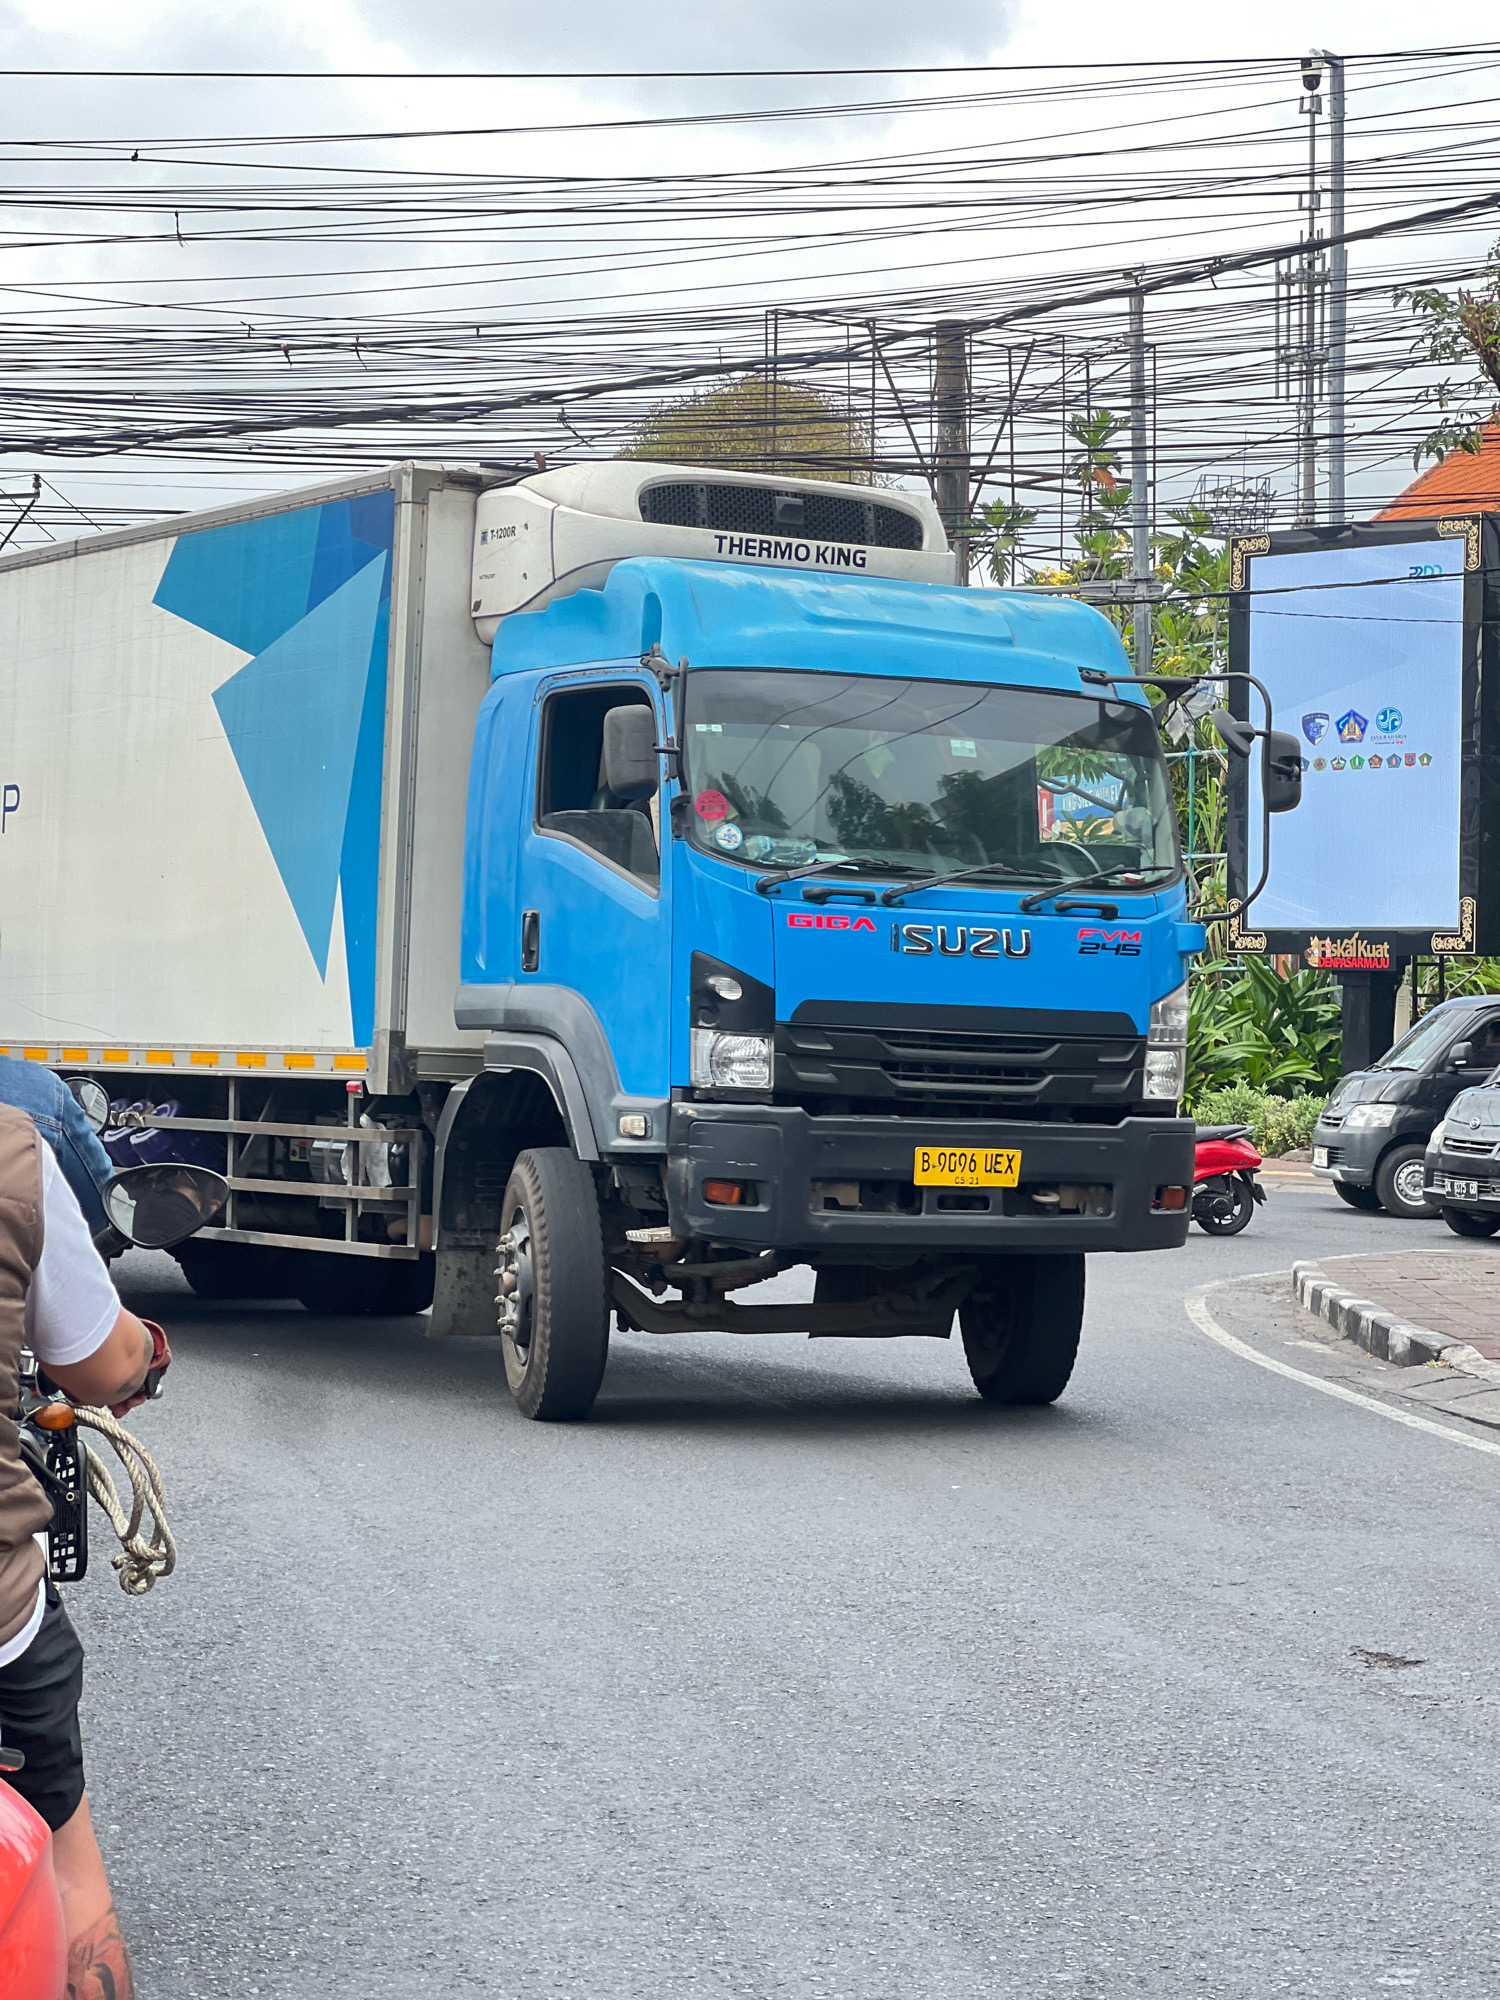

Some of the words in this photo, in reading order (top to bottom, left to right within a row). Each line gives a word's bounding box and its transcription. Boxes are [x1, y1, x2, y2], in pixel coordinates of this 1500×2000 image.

[490, 525, 517, 540] T-1200R
[714, 534, 811, 562] THERMO
[815, 544, 867, 568] KING
[787, 913, 877, 931] GIGA
[890, 923, 1031, 959] ISUZU
[1077, 928, 1142, 943] FVM
[1078, 942, 1143, 956] 245
[1357, 940, 1390, 957] Kuat
[921, 1152, 930, 1172] B
[938, 1152, 977, 1173] 9096
[984, 1153, 1015, 1174] UEX
